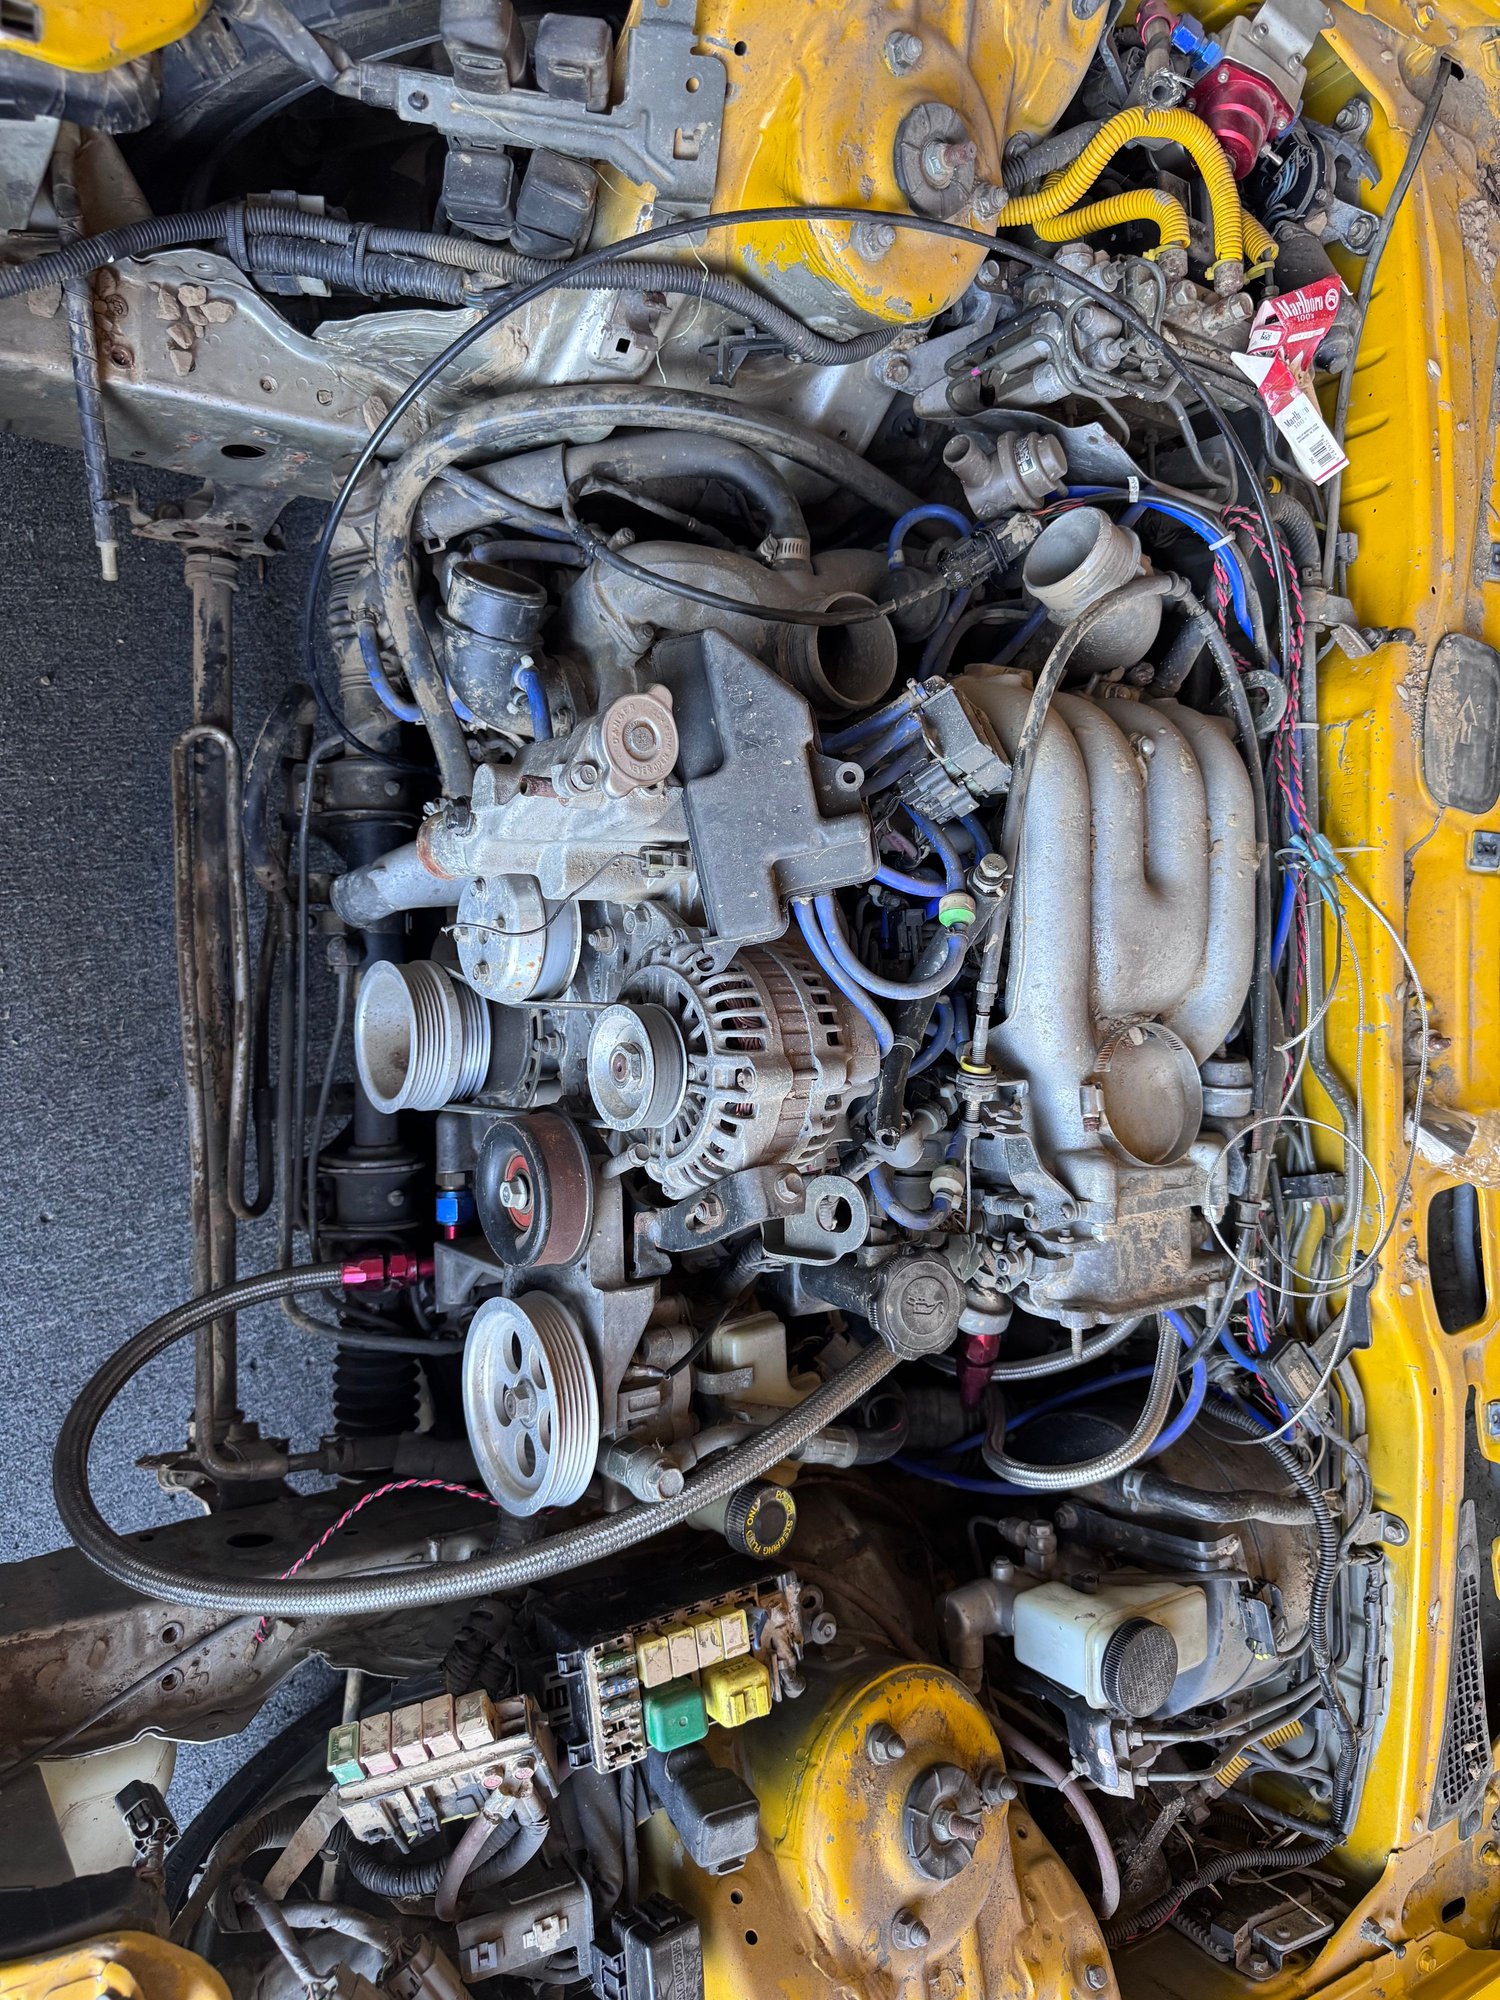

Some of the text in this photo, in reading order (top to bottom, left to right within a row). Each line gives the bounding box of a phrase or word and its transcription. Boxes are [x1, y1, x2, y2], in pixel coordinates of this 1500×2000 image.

[1275, 290, 1324, 320] Marlboro
[612, 703, 635, 744] DANGER
[746, 1490, 795, 1555] POWER STEERING FLUID ONLY
